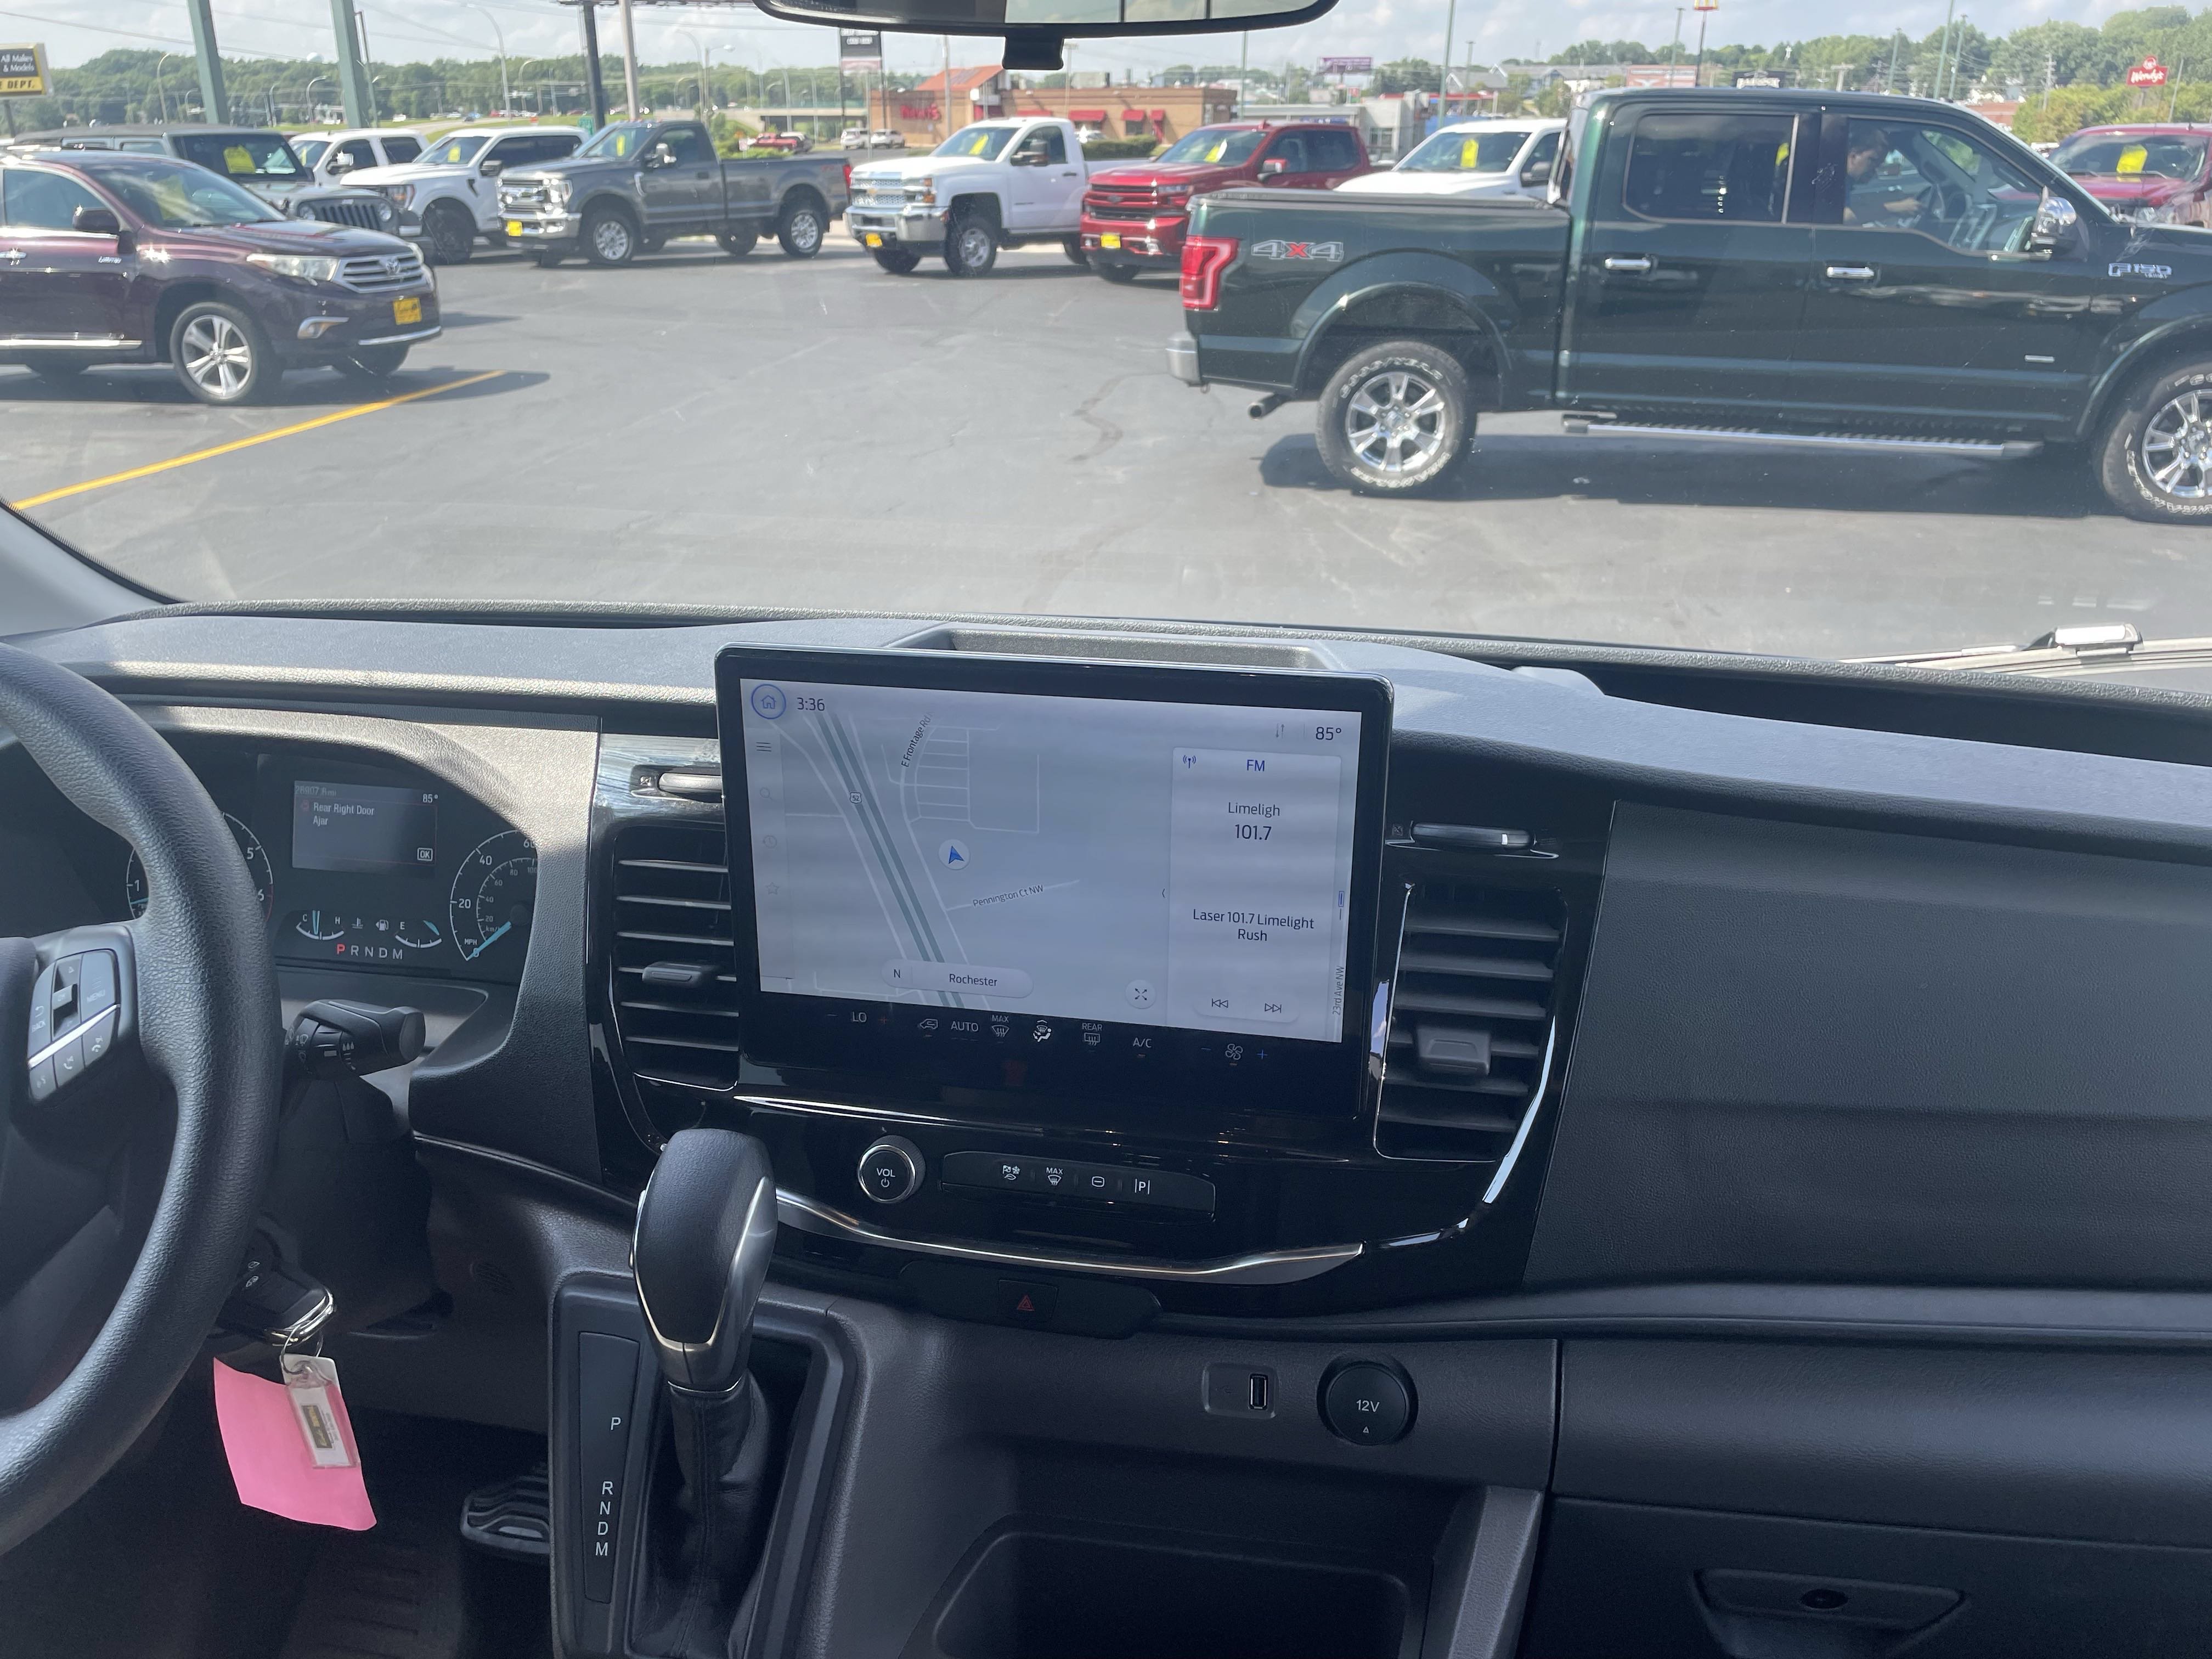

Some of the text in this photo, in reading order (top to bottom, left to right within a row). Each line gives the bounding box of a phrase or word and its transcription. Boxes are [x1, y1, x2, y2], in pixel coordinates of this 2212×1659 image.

[797, 697, 825, 711] 3:36
[903, 726, 924, 761] Frontage
[919, 715, 931, 727] Rd
[1316, 726, 1342, 741] 85°
[1246, 759, 1265, 772] FM
[313, 802, 375, 816] Rear Right Door
[1228, 802, 1280, 818] Limeligh
[313, 815, 329, 827] Ajar
[1234, 823, 1272, 840] 101.7
[247, 847, 254, 860] 5
[420, 850, 430, 859] OK
[479, 855, 492, 866] 40
[510, 868, 518, 877] 80
[134, 879, 140, 891] 1
[257, 889, 264, 901] 6
[973, 884, 1043, 907] Pennington Ct NW
[459, 899, 471, 909] 20
[302, 913, 340, 925] C H
[400, 921, 405, 930] E
[1193, 909, 1314, 930] Laser 101.7 Limelight
[1238, 928, 1267, 941] Rush
[337, 944, 403, 960] P R N D M
[893, 969, 901, 978] N
[949, 973, 997, 987] Rochester
[86, 989, 106, 1002] MENU
[1333, 965, 1345, 1015] 23rd Ave NW
[852, 1011, 868, 1023] LO
[991, 1014, 1009, 1023] MAX
[951, 1020, 979, 1032] AUTO
[1082, 1023, 1103, 1031] REAR
[1133, 1037, 1152, 1048] A/C
[876, 1167, 896, 1178] VOL
[1046, 1167, 1064, 1175] MAX
[1356, 1399, 1380, 1413] 12V
[610, 1417, 622, 1431] P
[601, 1481, 613, 1495] R
[600, 1501, 611, 1515] N
[597, 1522, 609, 1536] D
[595, 1542, 608, 1556] M
